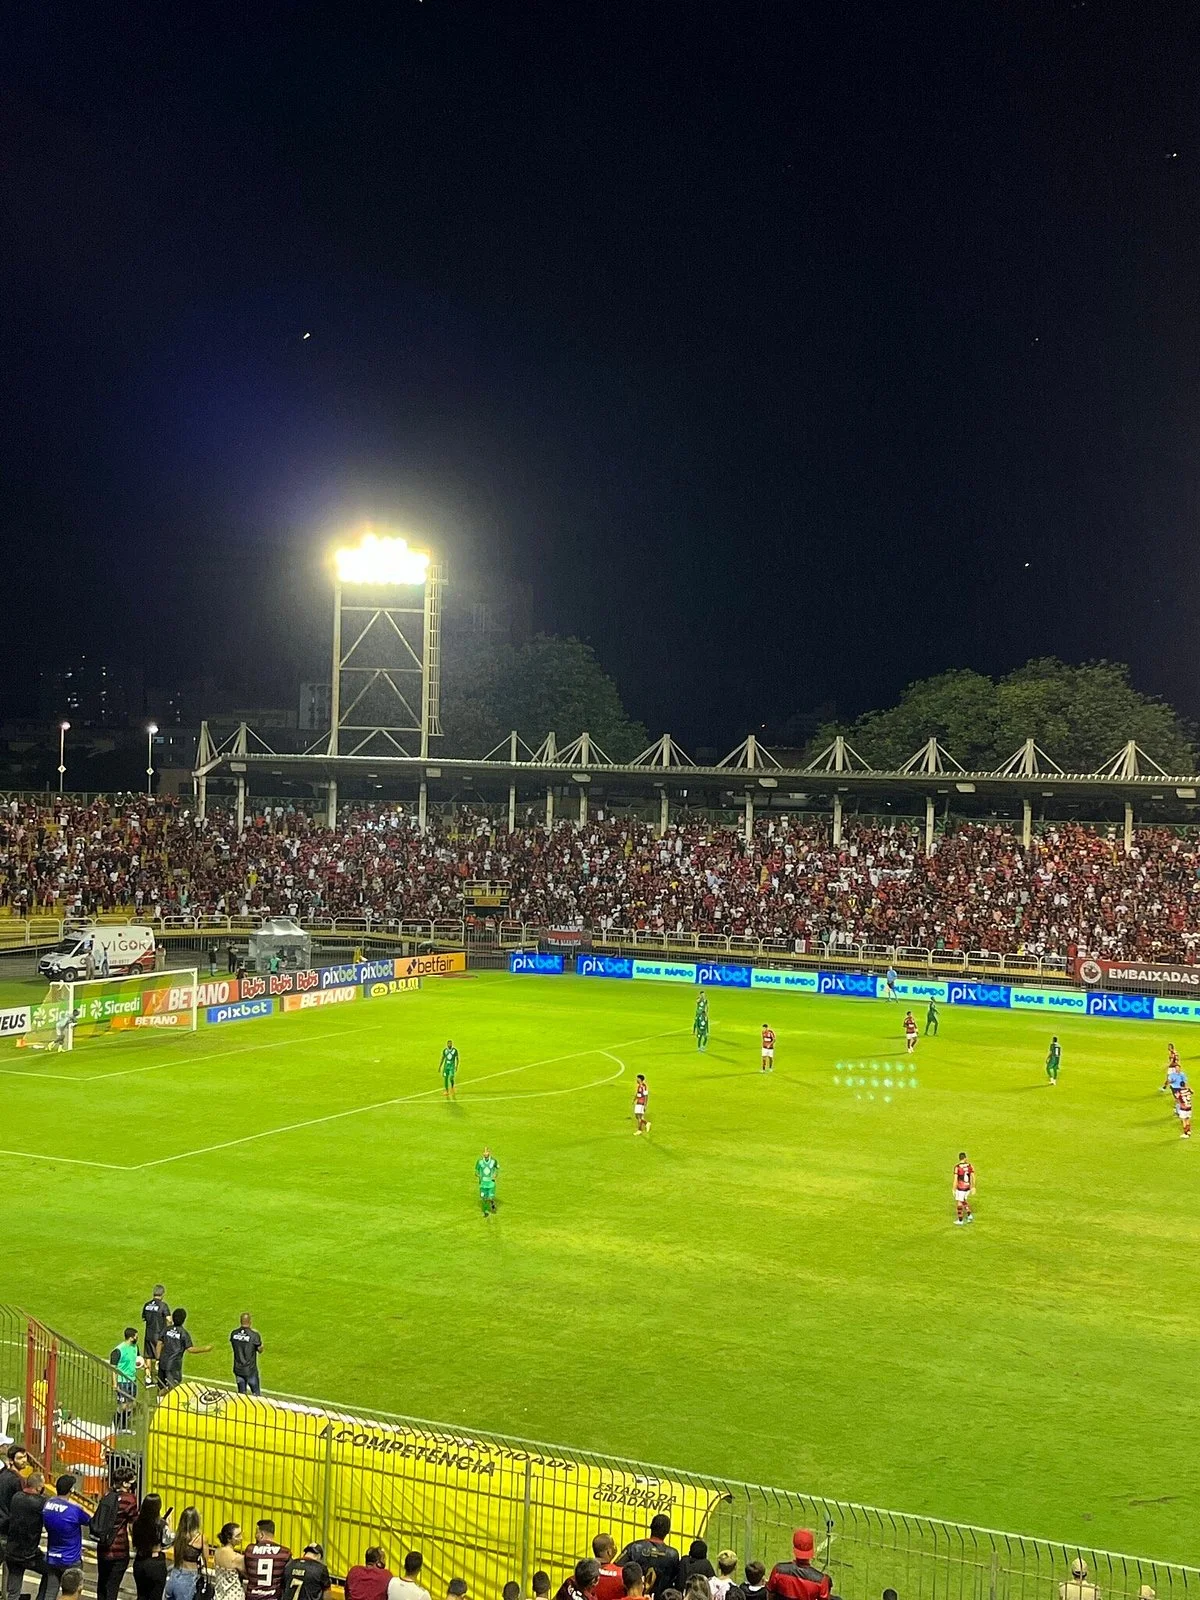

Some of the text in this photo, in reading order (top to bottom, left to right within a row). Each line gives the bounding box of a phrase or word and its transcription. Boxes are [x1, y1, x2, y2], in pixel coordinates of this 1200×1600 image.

[101, 940, 147, 952] VIGOR
[361, 960, 393, 983] pixbet
[417, 955, 454, 973] betfair
[513, 955, 560, 972] pixbet
[582, 957, 631, 975] pixbet
[636, 966, 661, 975] SAQUE
[322, 963, 358, 988] pixbet
[699, 965, 749, 984] pixbet
[754, 975, 781, 984] SAQUE
[821, 974, 874, 993] pixbet
[1108, 968, 1200, 985] EMBAIXADAS
[168, 982, 230, 1011] BETANO
[300, 987, 356, 1009] BETANO
[951, 984, 1009, 1003] pixbet
[1014, 994, 1044, 1004] SAQUE
[104, 998, 140, 1015] Sicredi
[217, 1002, 267, 1022] pixbet
[1090, 995, 1151, 1014] pixbet
[1158, 1005, 1189, 1015] SAQUE
[0, 1014, 26, 1030] EUS
[135, 1015, 178, 1025] BETANO
[592, 1491, 672, 1514] CIDADANIA
[252, 1545, 281, 1555] MRV
[257, 1558, 274, 1587] 9
[289, 1578, 304, 1600] 7
